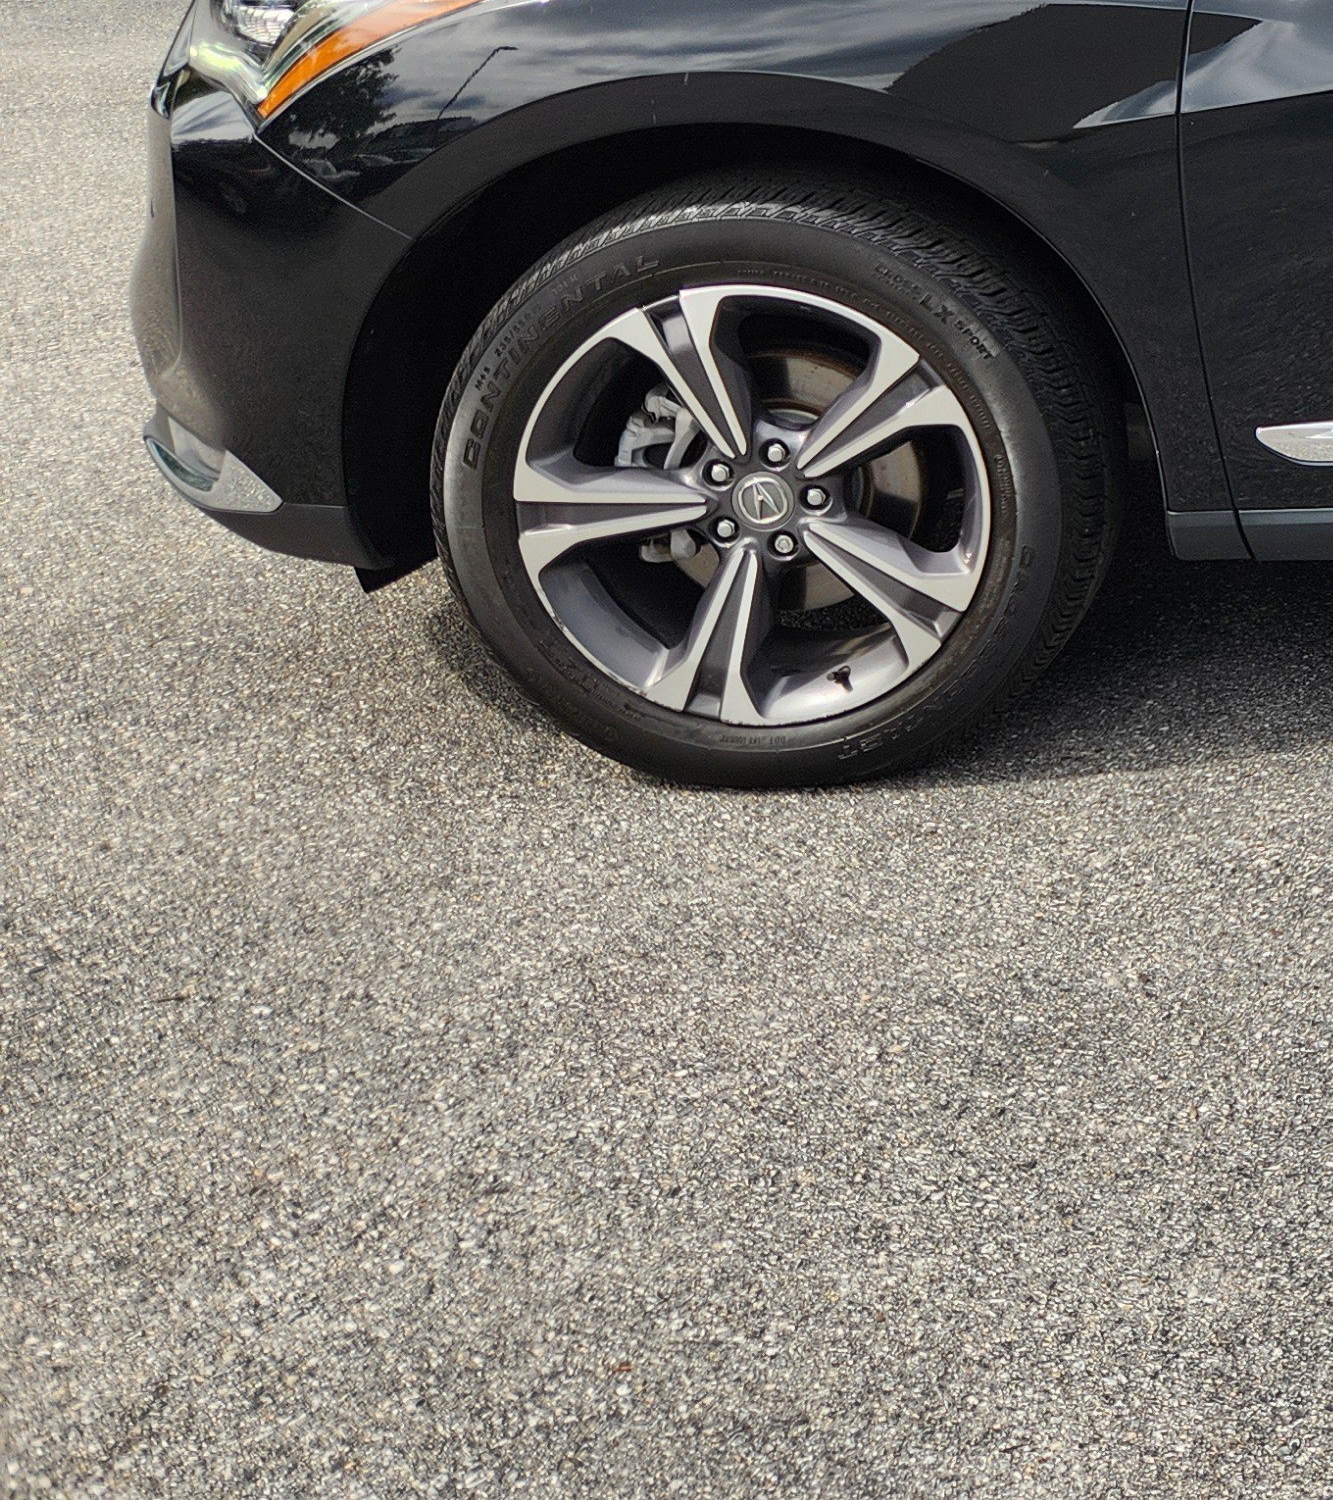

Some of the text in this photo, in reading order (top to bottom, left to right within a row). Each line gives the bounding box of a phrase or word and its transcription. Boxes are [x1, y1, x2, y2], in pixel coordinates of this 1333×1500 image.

[463, 255, 660, 469] CONTINENTAL
[919, 293, 955, 324] LX
[954, 320, 993, 360] SPORT
